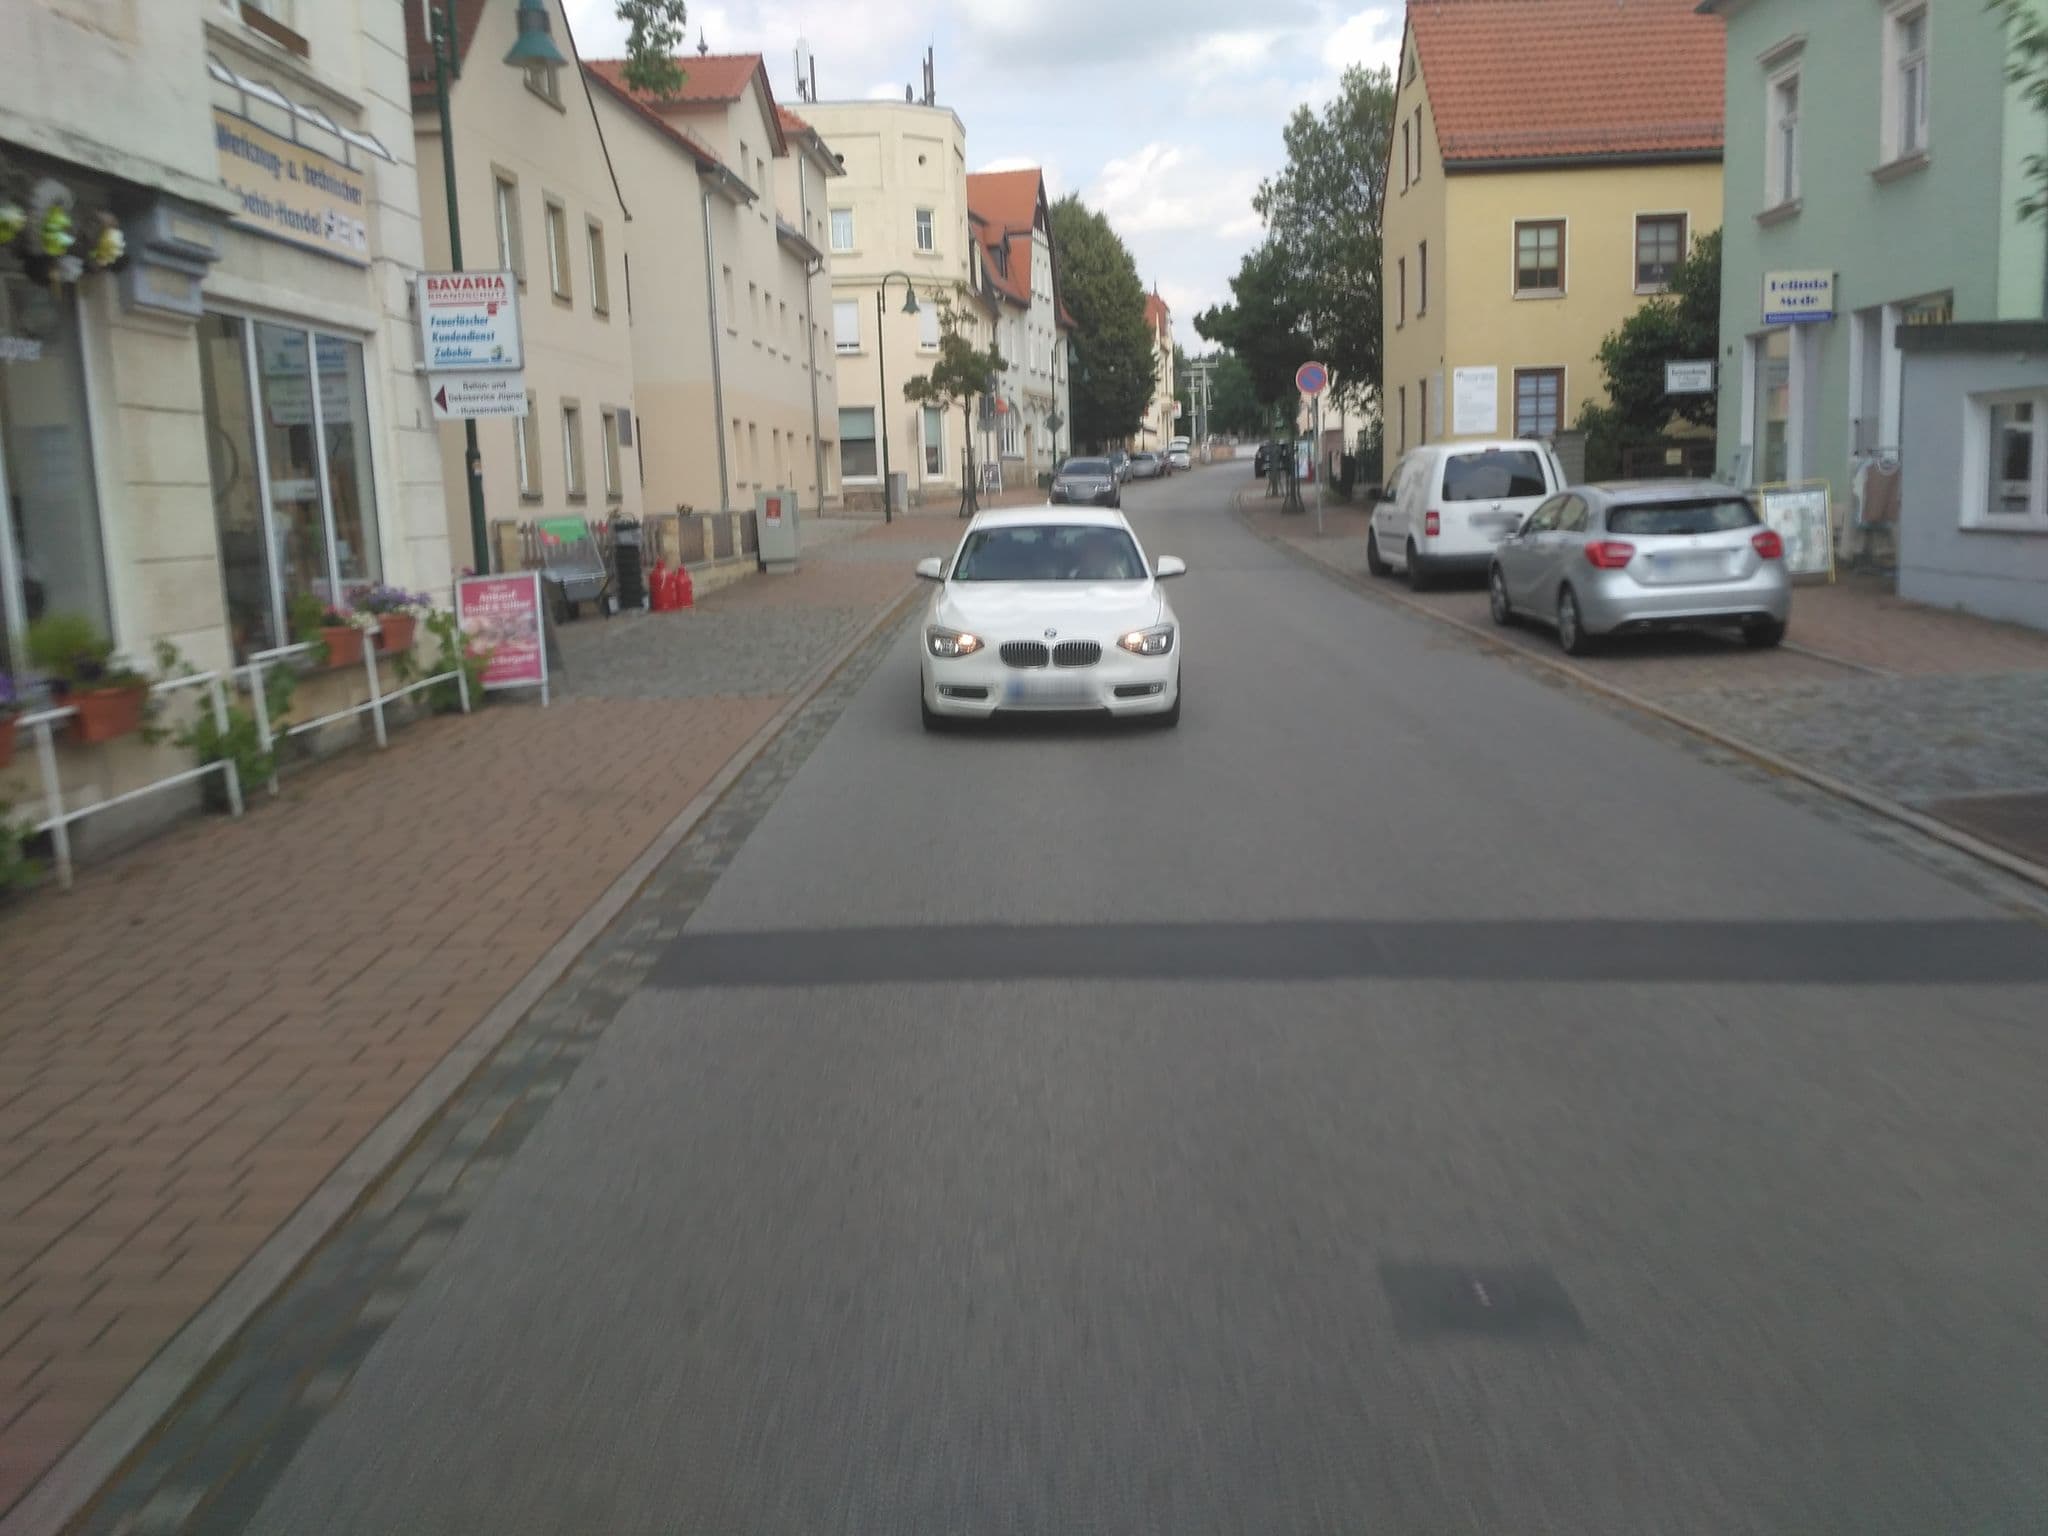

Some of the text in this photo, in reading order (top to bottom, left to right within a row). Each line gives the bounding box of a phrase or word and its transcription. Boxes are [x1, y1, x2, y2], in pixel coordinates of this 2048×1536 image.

[427, 275, 505, 290] BAVARIA
[431, 313, 489, 328] Feuerlöscher
[432, 330, 495, 343] Kundendienst
[434, 347, 472, 358] Zubehör
